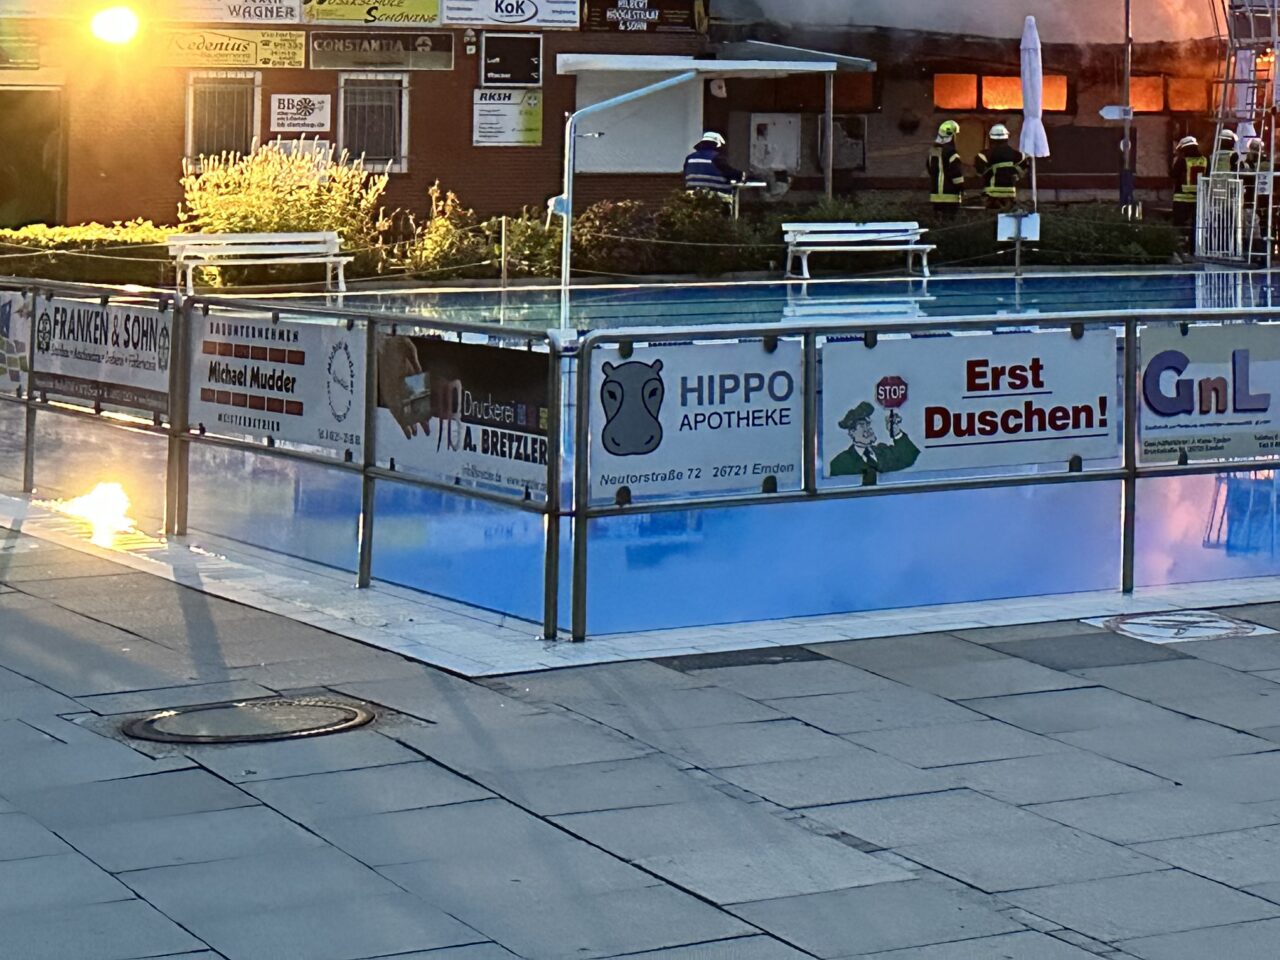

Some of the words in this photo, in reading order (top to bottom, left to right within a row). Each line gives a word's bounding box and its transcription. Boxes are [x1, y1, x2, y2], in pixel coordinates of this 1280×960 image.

[228, 5, 295, 19] WAGNER
[495, 0, 526, 15] KoK
[313, 38, 405, 52] CONSTANTIA
[277, 98, 295, 110] BB
[480, 93, 512, 101] RKSH
[53, 306, 109, 346] FRANKEN
[112, 315, 120, 348] &
[124, 314, 159, 353] SOHN
[208, 361, 247, 387] Michael
[249, 365, 297, 394] Mudder
[680, 370, 795, 407] HIPPO
[966, 358, 1044, 393] Erst
[1143, 349, 1271, 417] GnL
[877, 384, 906, 400] STOP
[463, 390, 515, 423] Druckerei
[679, 408, 792, 431] APOTHEKE
[925, 396, 1108, 439] Duschen!
[463, 426, 477, 452] A.
[481, 428, 548, 466] BRETZLER
[600, 469, 683, 486] Neutorstraße
[687, 468, 702, 480] 72
[713, 464, 748, 477] 26721
[752, 463, 795, 475] Emden
